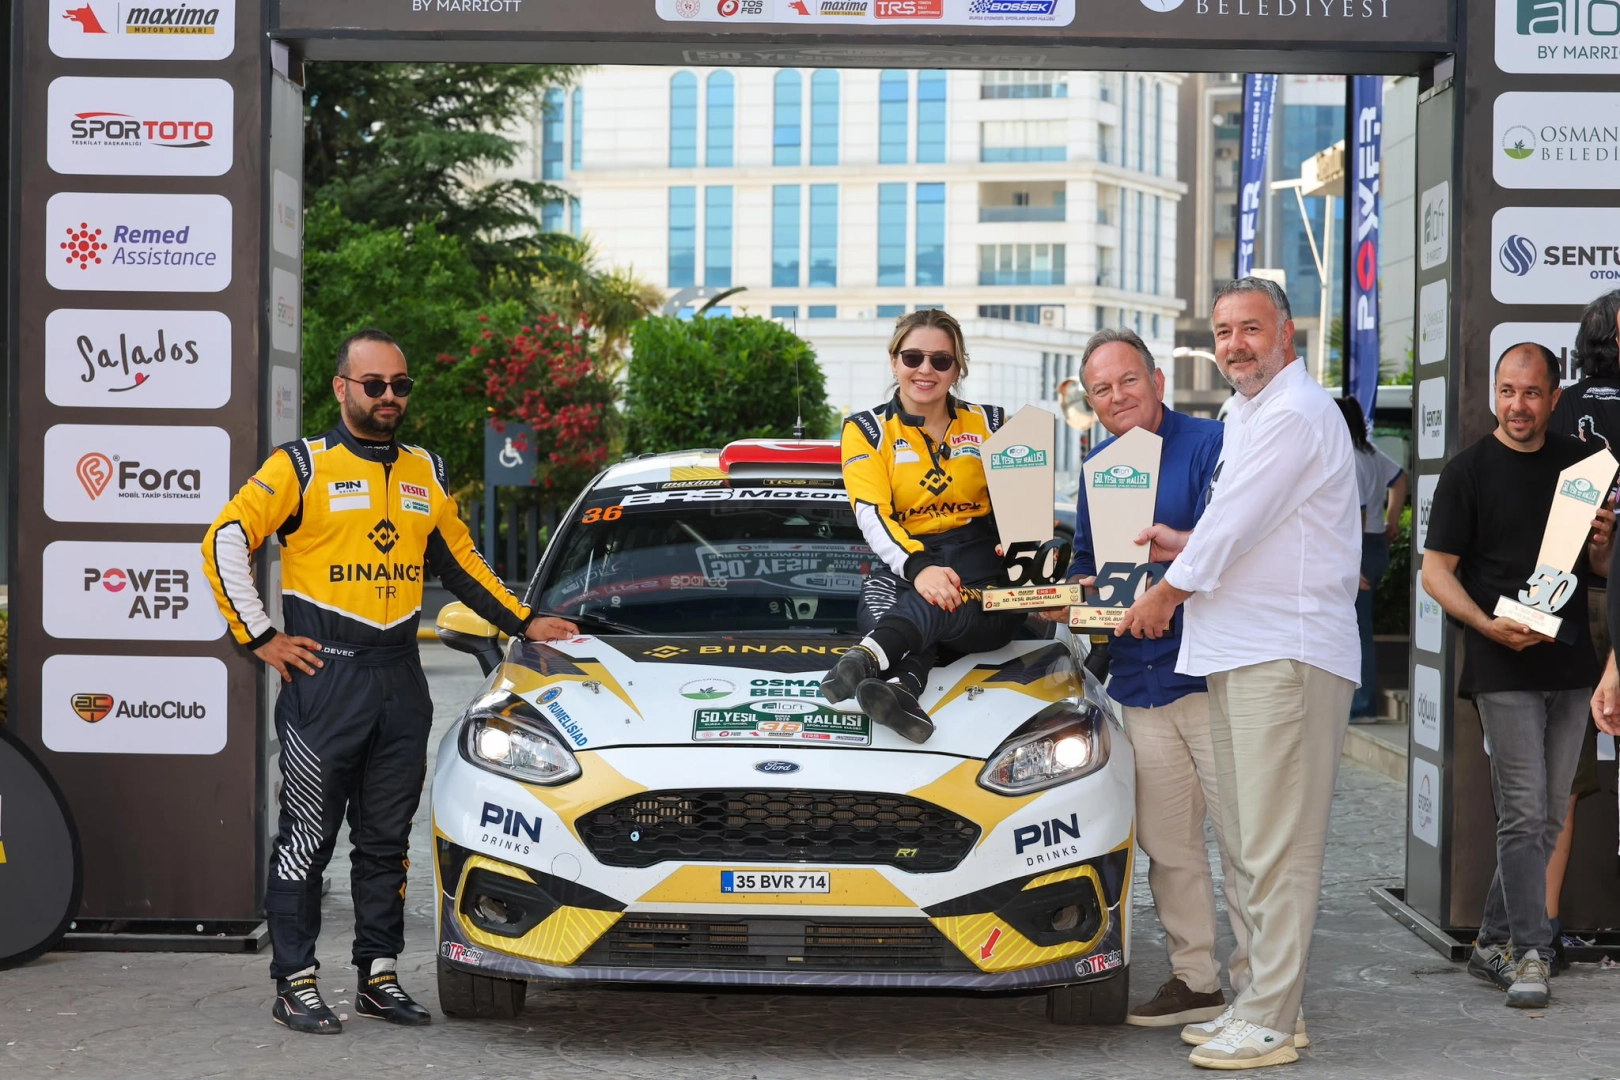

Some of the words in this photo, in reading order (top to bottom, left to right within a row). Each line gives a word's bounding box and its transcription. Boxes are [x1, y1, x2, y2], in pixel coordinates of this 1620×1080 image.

[126, 3, 220, 26] maxima
[412, 0, 432, 12] BY
[437, 0, 522, 12] MARRIOTT
[820, 0, 868, 11] maxima
[877, 0, 916, 15] TRS
[990, 3, 1049, 12] BOSSEK
[1538, 46, 1558, 59] BY
[1564, 46, 1620, 60] MARRI
[1356, 107, 1381, 330] POWER
[113, 225, 190, 244] Remed
[112, 247, 216, 266] Assistance
[77, 329, 199, 382] Salados
[952, 434, 980, 445] VESTEL
[292, 446, 309, 478] MARINA
[119, 461, 200, 491] Fora
[662, 480, 723, 489] maxima
[334, 481, 362, 490] PIN
[401, 484, 428, 497] VESTEL
[738, 490, 850, 499] Motor
[582, 505, 623, 524] 36
[1000, 539, 1072, 586] 50
[84, 568, 189, 592] POWER
[670, 575, 728, 589] sparco
[1518, 564, 1578, 614] 50
[375, 586, 397, 599] TR
[128, 595, 189, 619] APP
[320, 645, 355, 657] .DEVEC
[699, 645, 850, 655] BINANC
[750, 679, 822, 687] OSMA
[116, 700, 206, 720] AutoClub
[547, 701, 588, 747] RUMELİSİAD
[759, 721, 801, 732] 36
[764, 761, 791, 772] Ford
[480, 801, 543, 844] PIN
[1014, 813, 1081, 855] PIN
[481, 836, 530, 855] DRINKS
[1026, 845, 1079, 867] DRINKS
[736, 875, 756, 888] 35
[760, 875, 794, 889] BVR
[798, 876, 827, 889] 714
[450, 943, 483, 961] TRacing
[1088, 950, 1121, 972] TRacing
